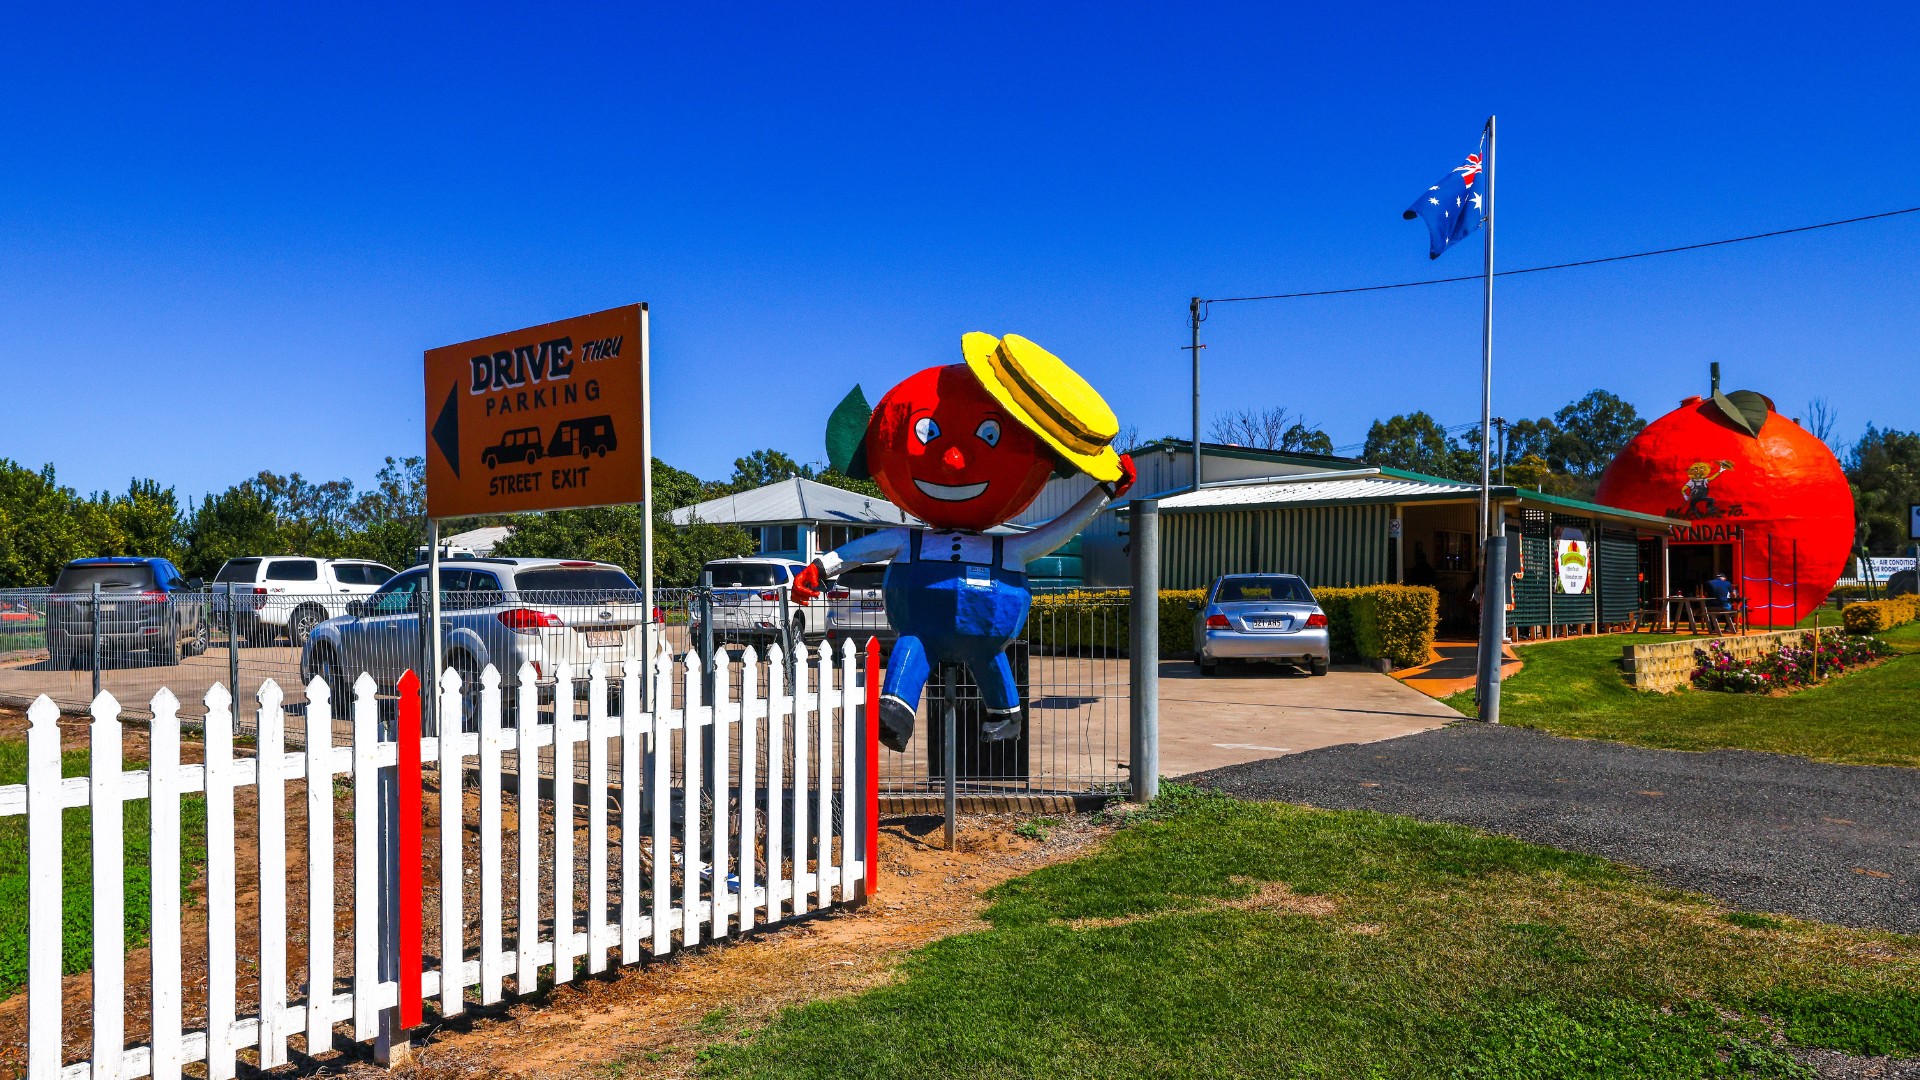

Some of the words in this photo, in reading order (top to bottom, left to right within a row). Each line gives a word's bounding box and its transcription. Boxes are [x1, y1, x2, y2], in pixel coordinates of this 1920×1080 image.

[469, 336, 574, 396] DRIVE
[581, 335, 624, 363] THRU
[486, 379, 600, 417] PARKING
[489, 472, 542, 496] STREET
[551, 466, 590, 490] EXIT
[1666, 523, 1741, 541] AYNDAH
